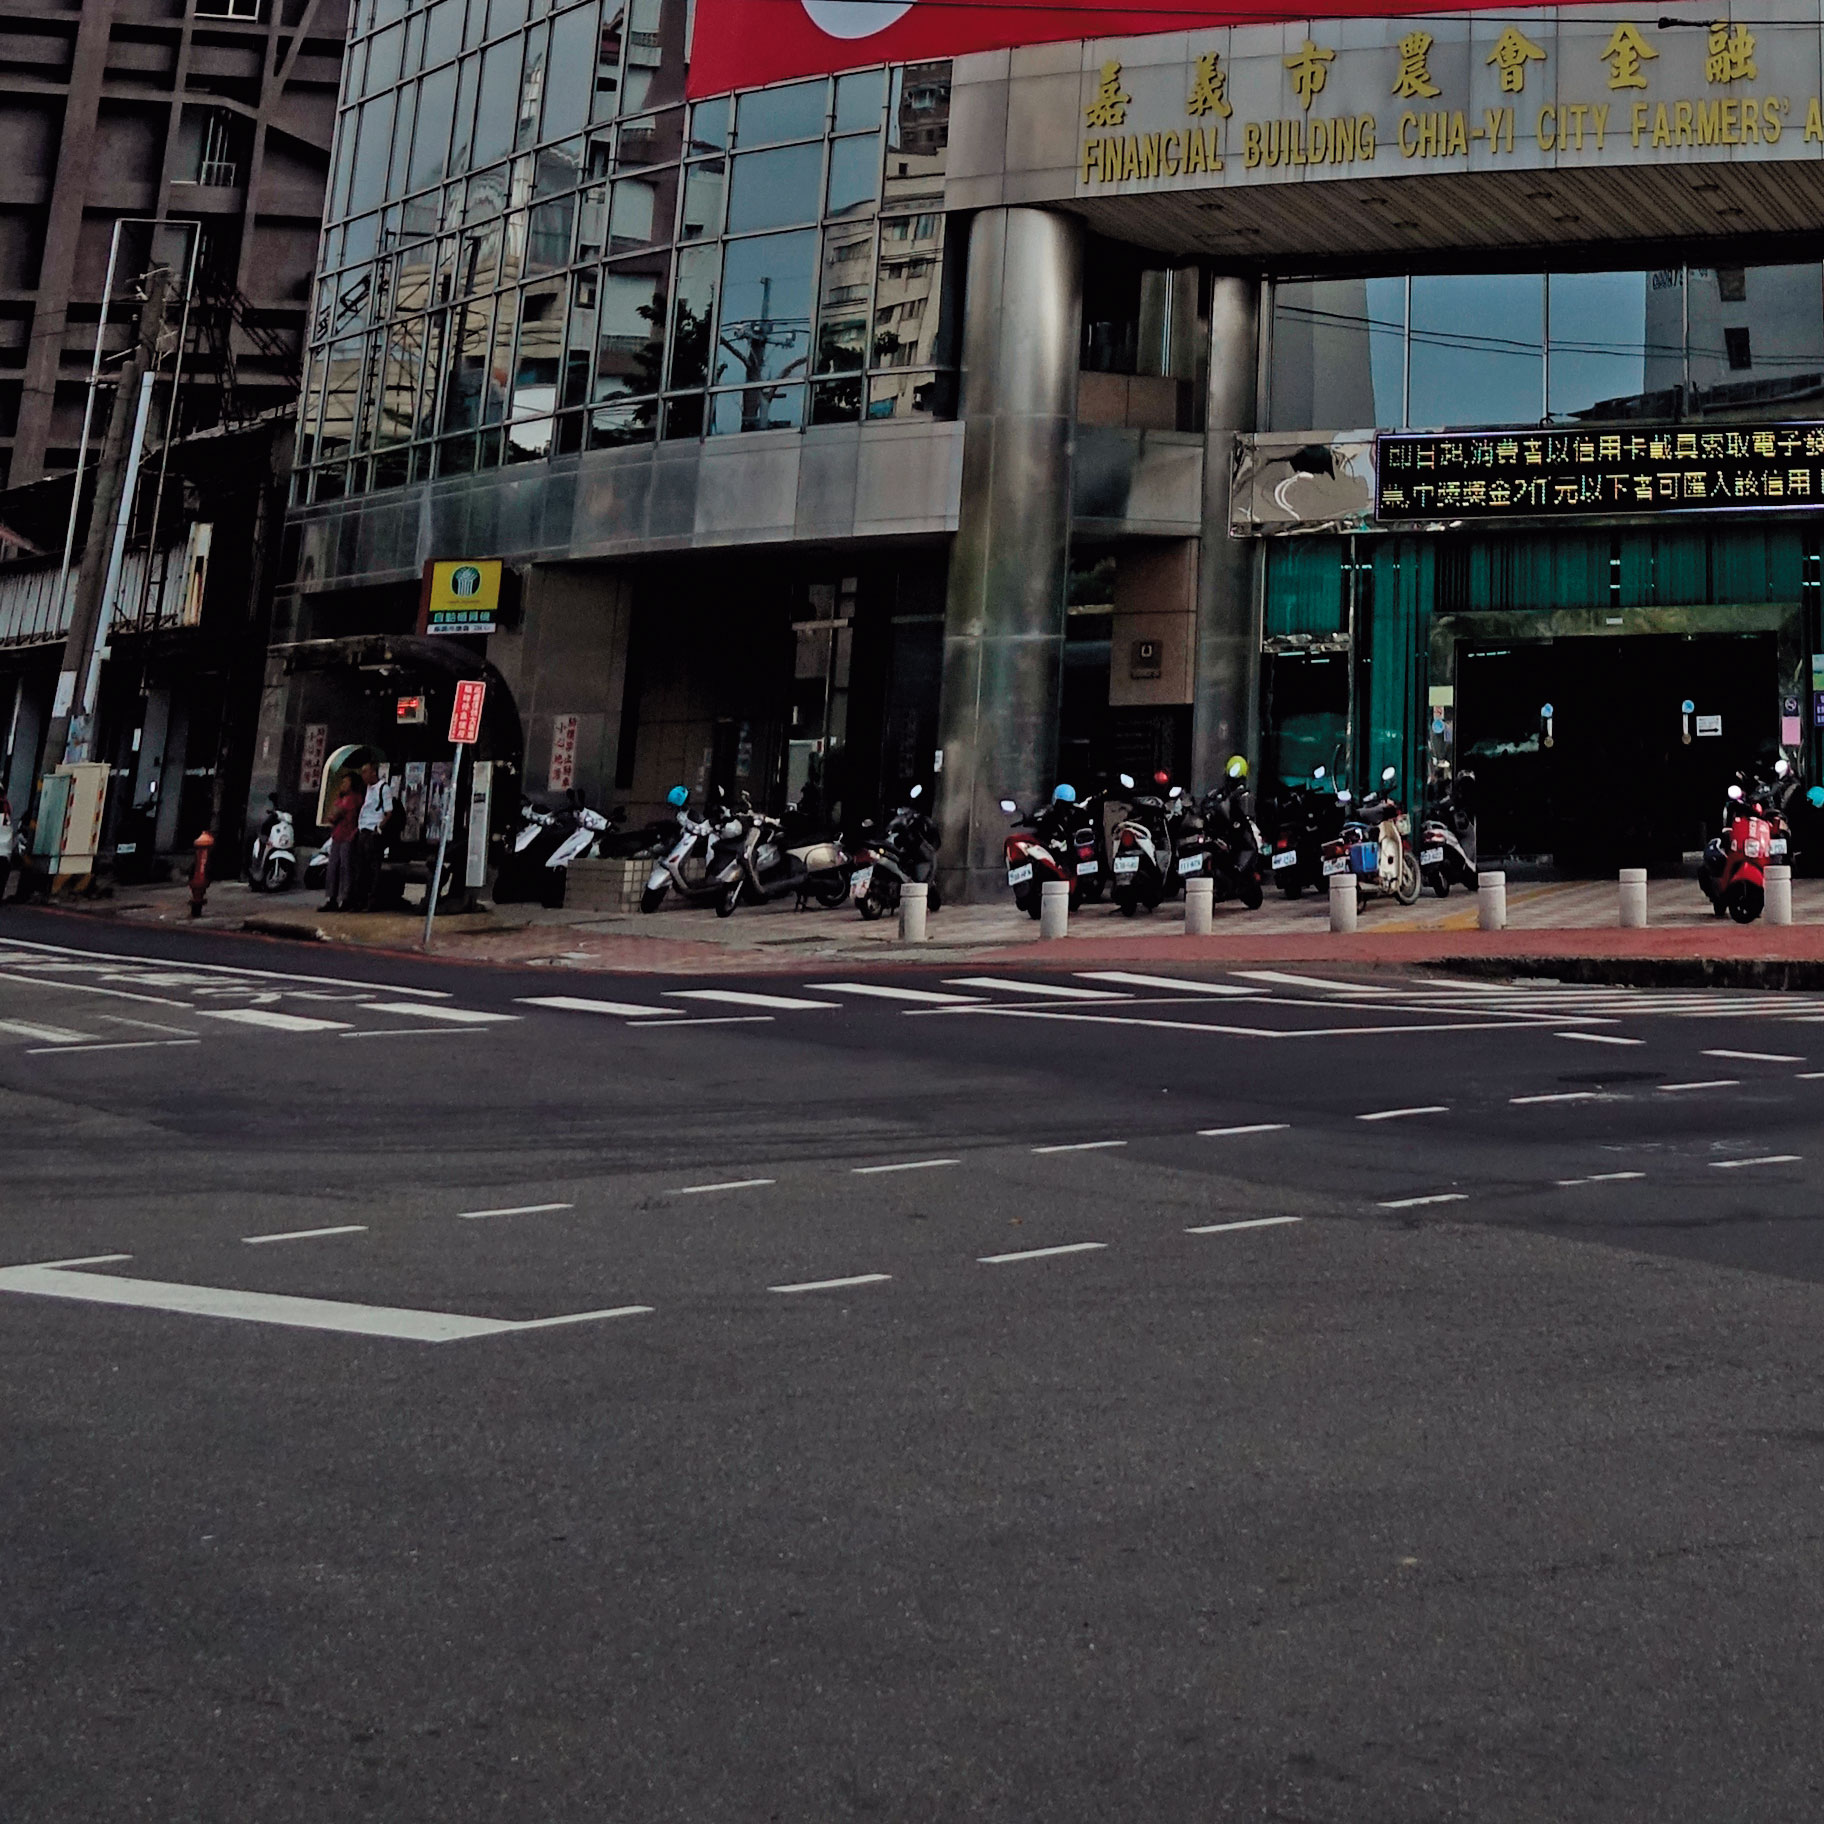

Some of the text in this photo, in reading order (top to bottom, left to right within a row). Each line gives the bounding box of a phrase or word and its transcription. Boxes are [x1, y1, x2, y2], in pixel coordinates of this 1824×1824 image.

[1081, 123, 1225, 185] FINANCIAL
[1243, 113, 1376, 167] BUILDING
[1402, 107, 1516, 159] CHIA-YI
[1537, 103, 1611, 152] CITY
[1631, 95, 1790, 148] FARMERS'
